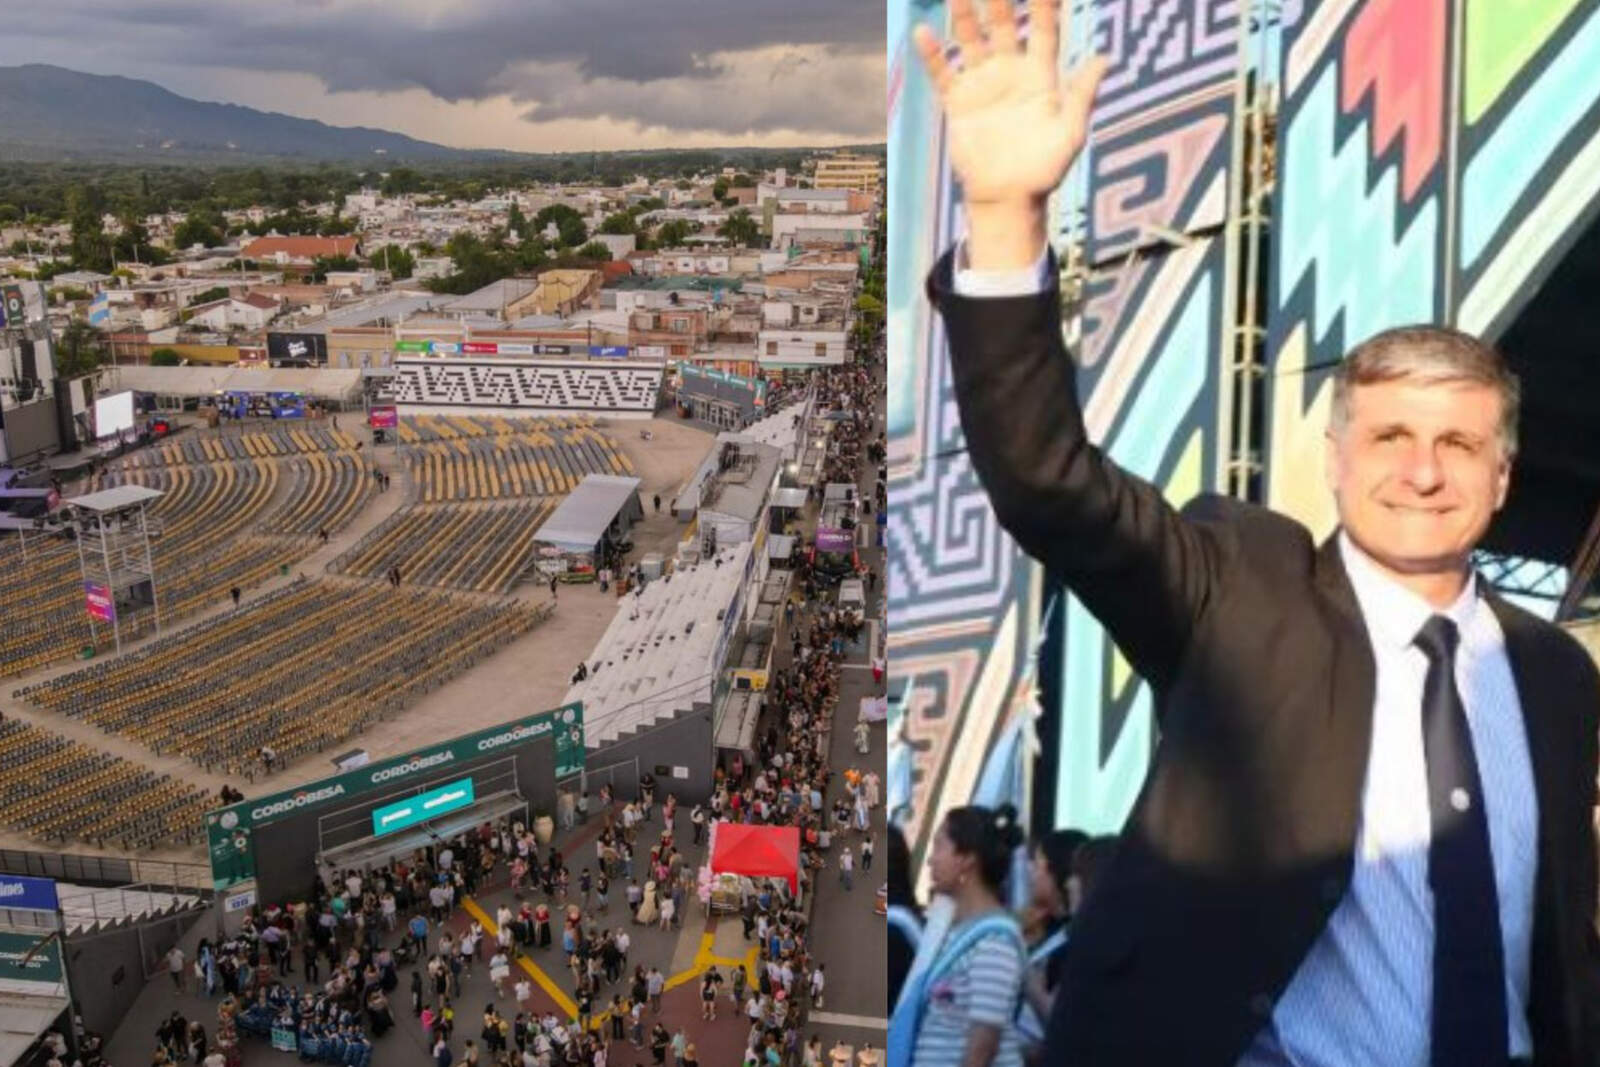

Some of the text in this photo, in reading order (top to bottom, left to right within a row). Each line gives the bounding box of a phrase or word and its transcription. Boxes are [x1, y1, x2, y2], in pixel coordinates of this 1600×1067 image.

[478, 721, 553, 751] CORDOBESA
[371, 750, 455, 783] CORDOBESA
[252, 784, 346, 820] CORDOBESA
